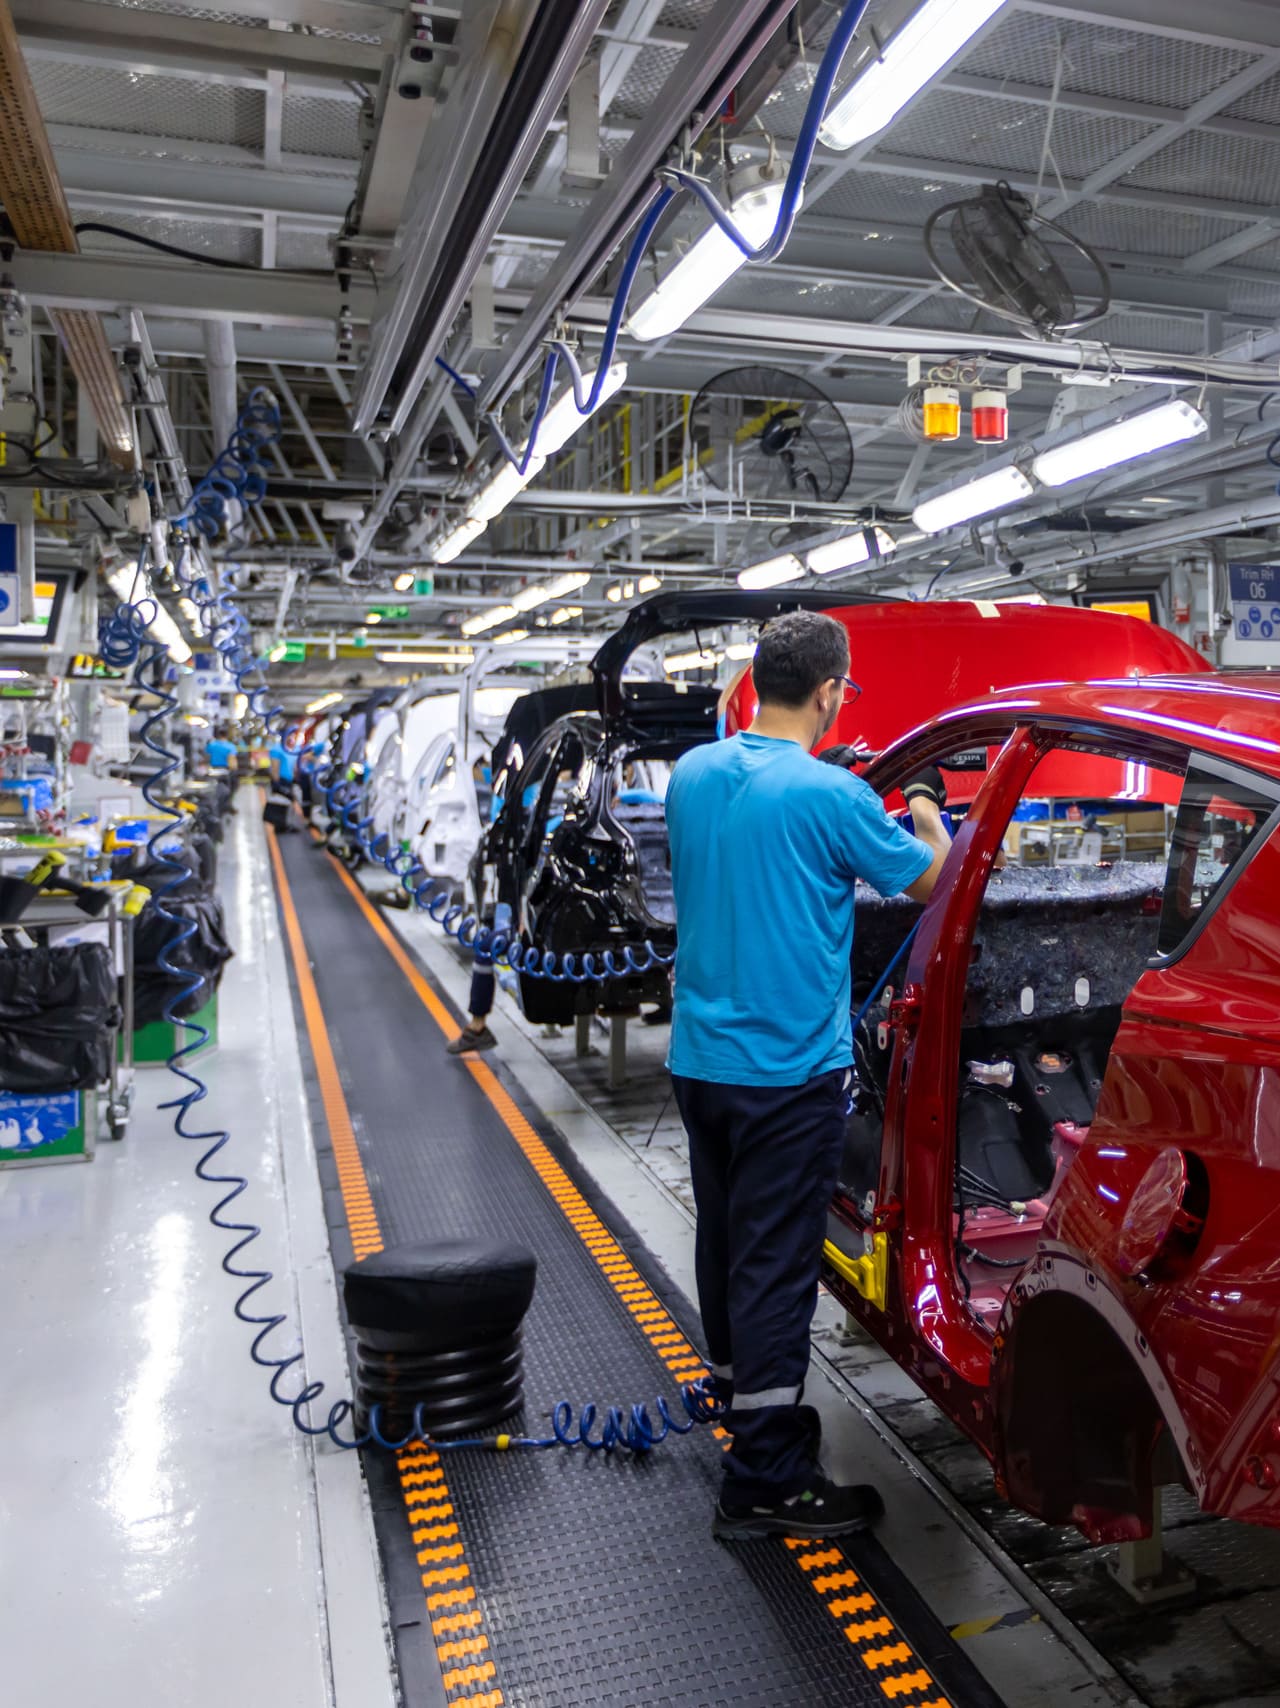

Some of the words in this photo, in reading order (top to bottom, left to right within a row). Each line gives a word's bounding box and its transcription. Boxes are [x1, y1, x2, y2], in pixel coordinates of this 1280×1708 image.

[1239, 567, 1259, 581] Trim
[1260, 567, 1275, 581] RH
[1249, 581, 1266, 600] 06
